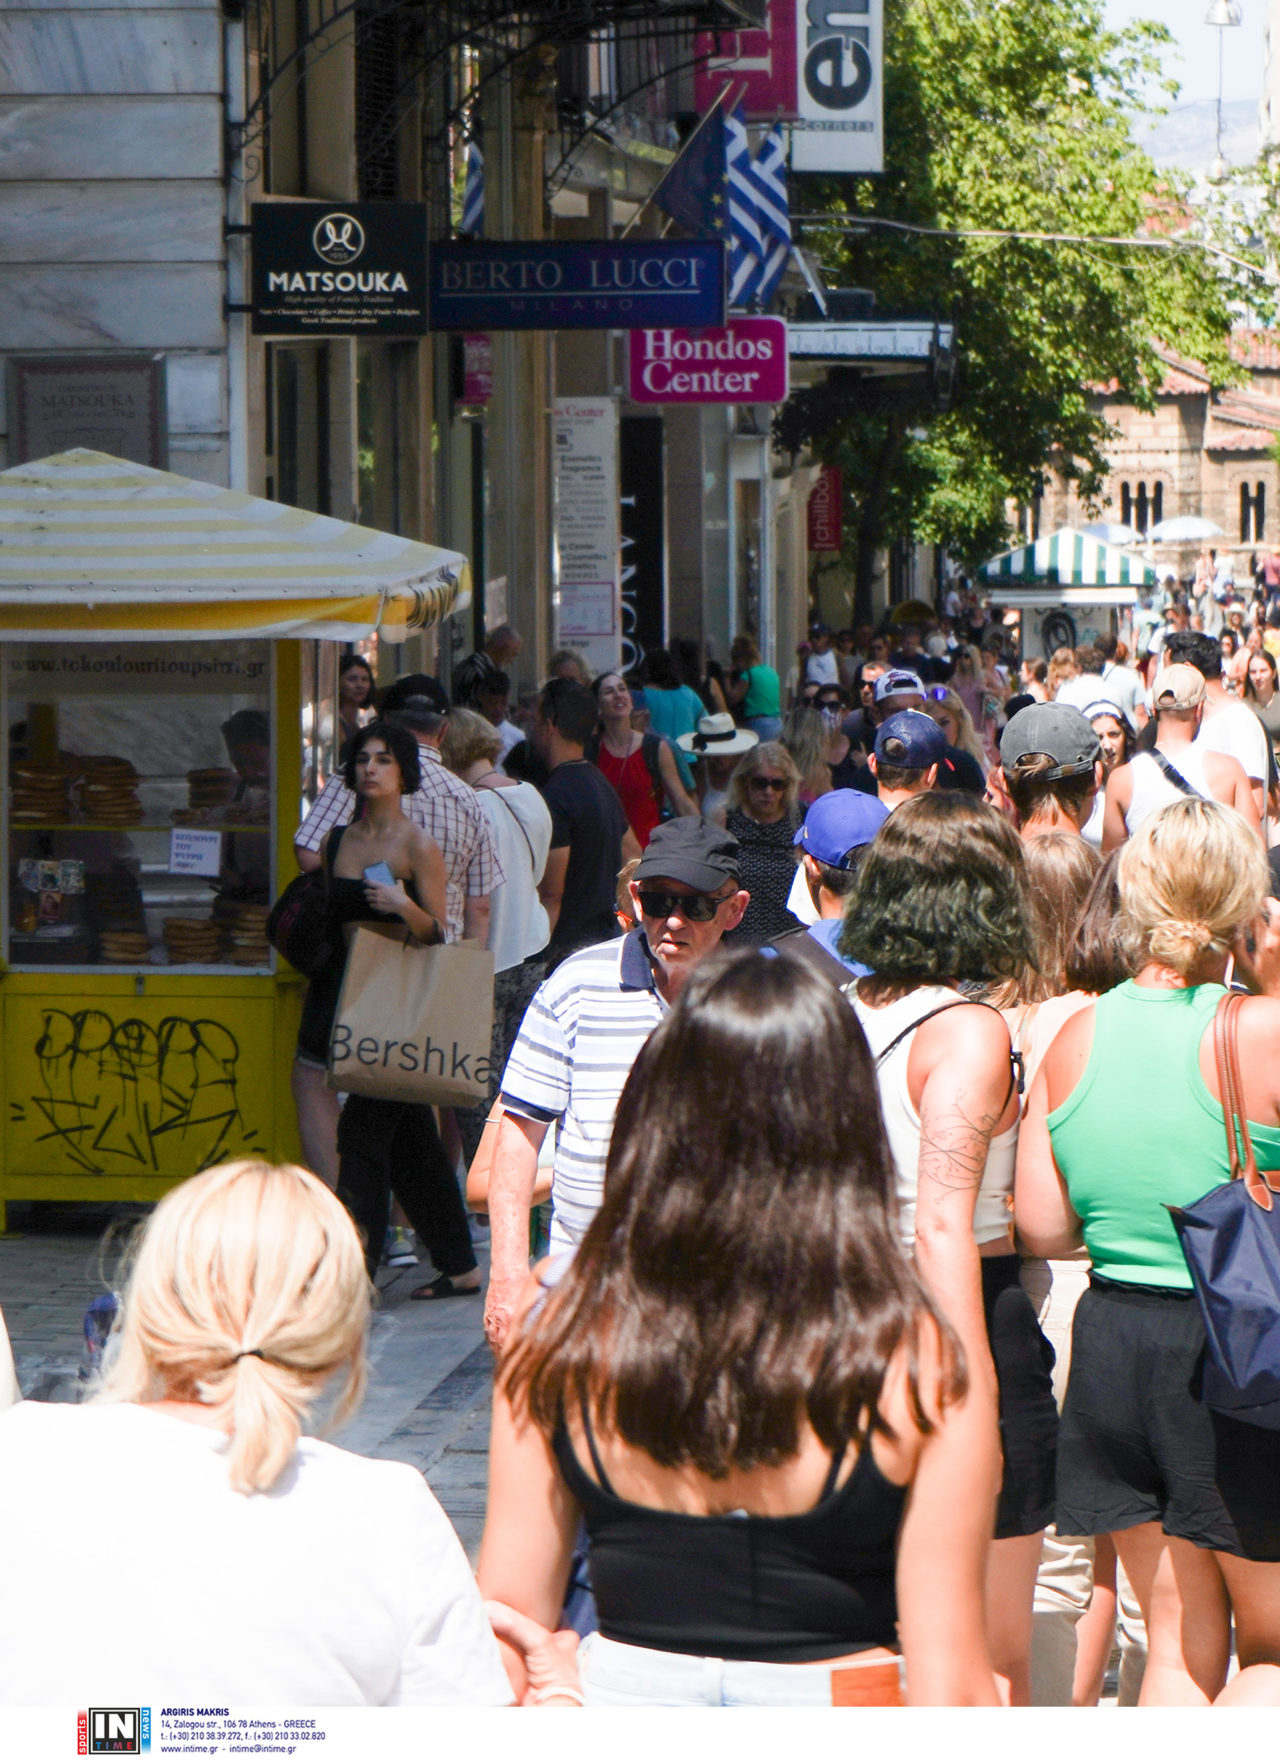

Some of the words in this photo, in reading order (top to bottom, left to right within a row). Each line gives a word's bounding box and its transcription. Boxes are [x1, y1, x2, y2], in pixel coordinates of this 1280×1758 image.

[268, 271, 409, 293] MATSOUKA
[441, 260, 563, 290] BERTO
[589, 257, 700, 288] LUCCI
[509, 298, 634, 313] MILANO
[642, 329, 774, 360] Hondos
[642, 361, 760, 393] Center
[331, 1024, 492, 1083] Bershka
